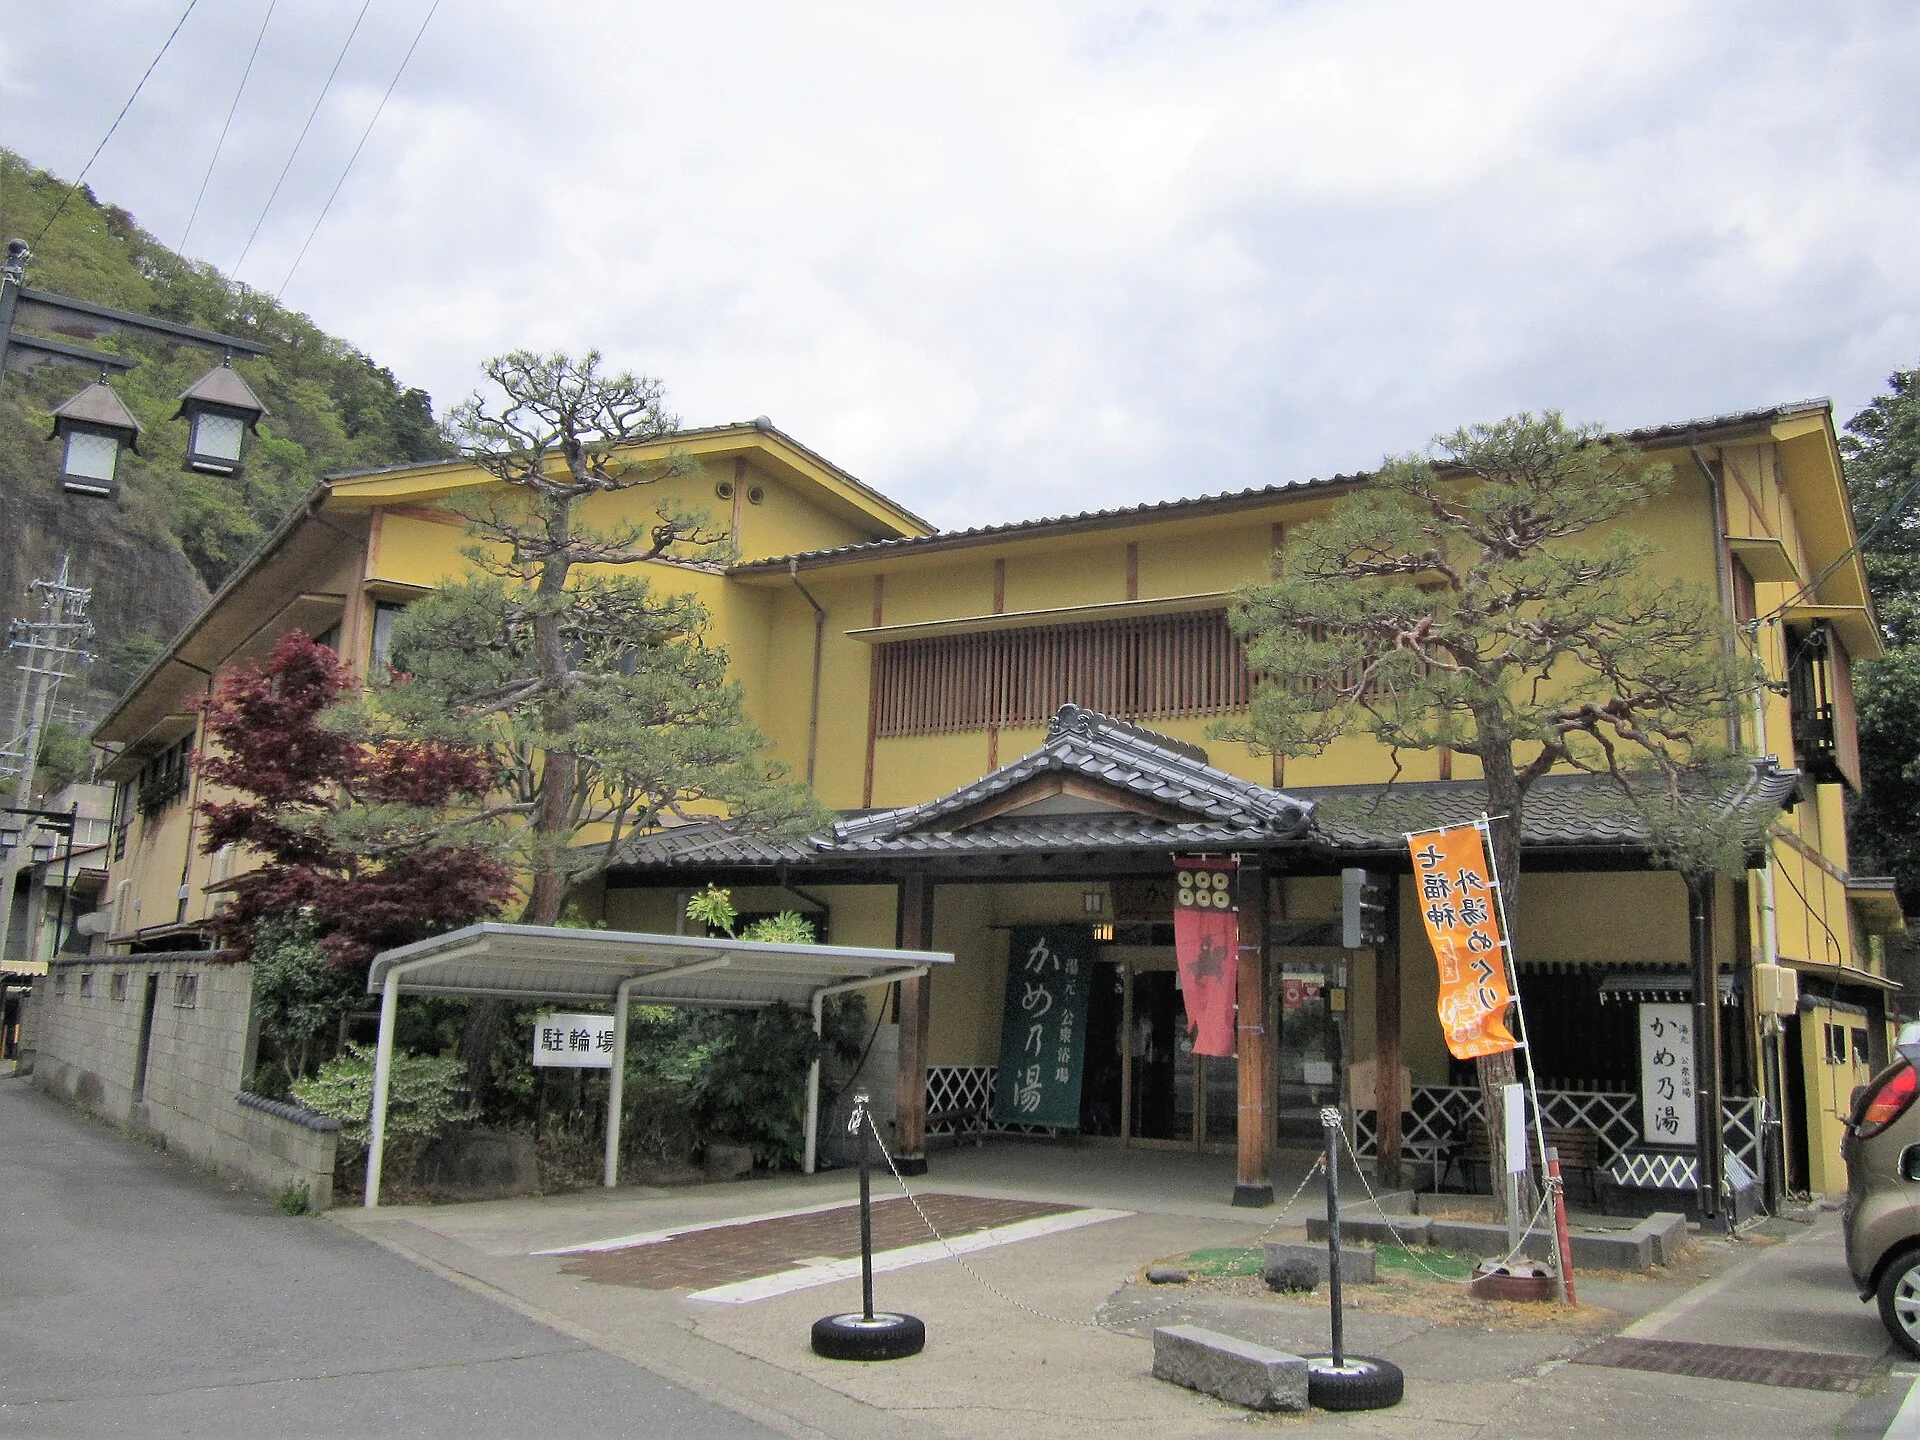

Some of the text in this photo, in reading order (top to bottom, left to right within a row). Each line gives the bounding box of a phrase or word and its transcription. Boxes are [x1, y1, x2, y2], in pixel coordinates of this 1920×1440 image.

[541, 1028, 614, 1053] 駐輪場
[1013, 937, 1060, 1113] かめ乃湯
[1650, 1017, 1680, 1136] かめ乃湯
